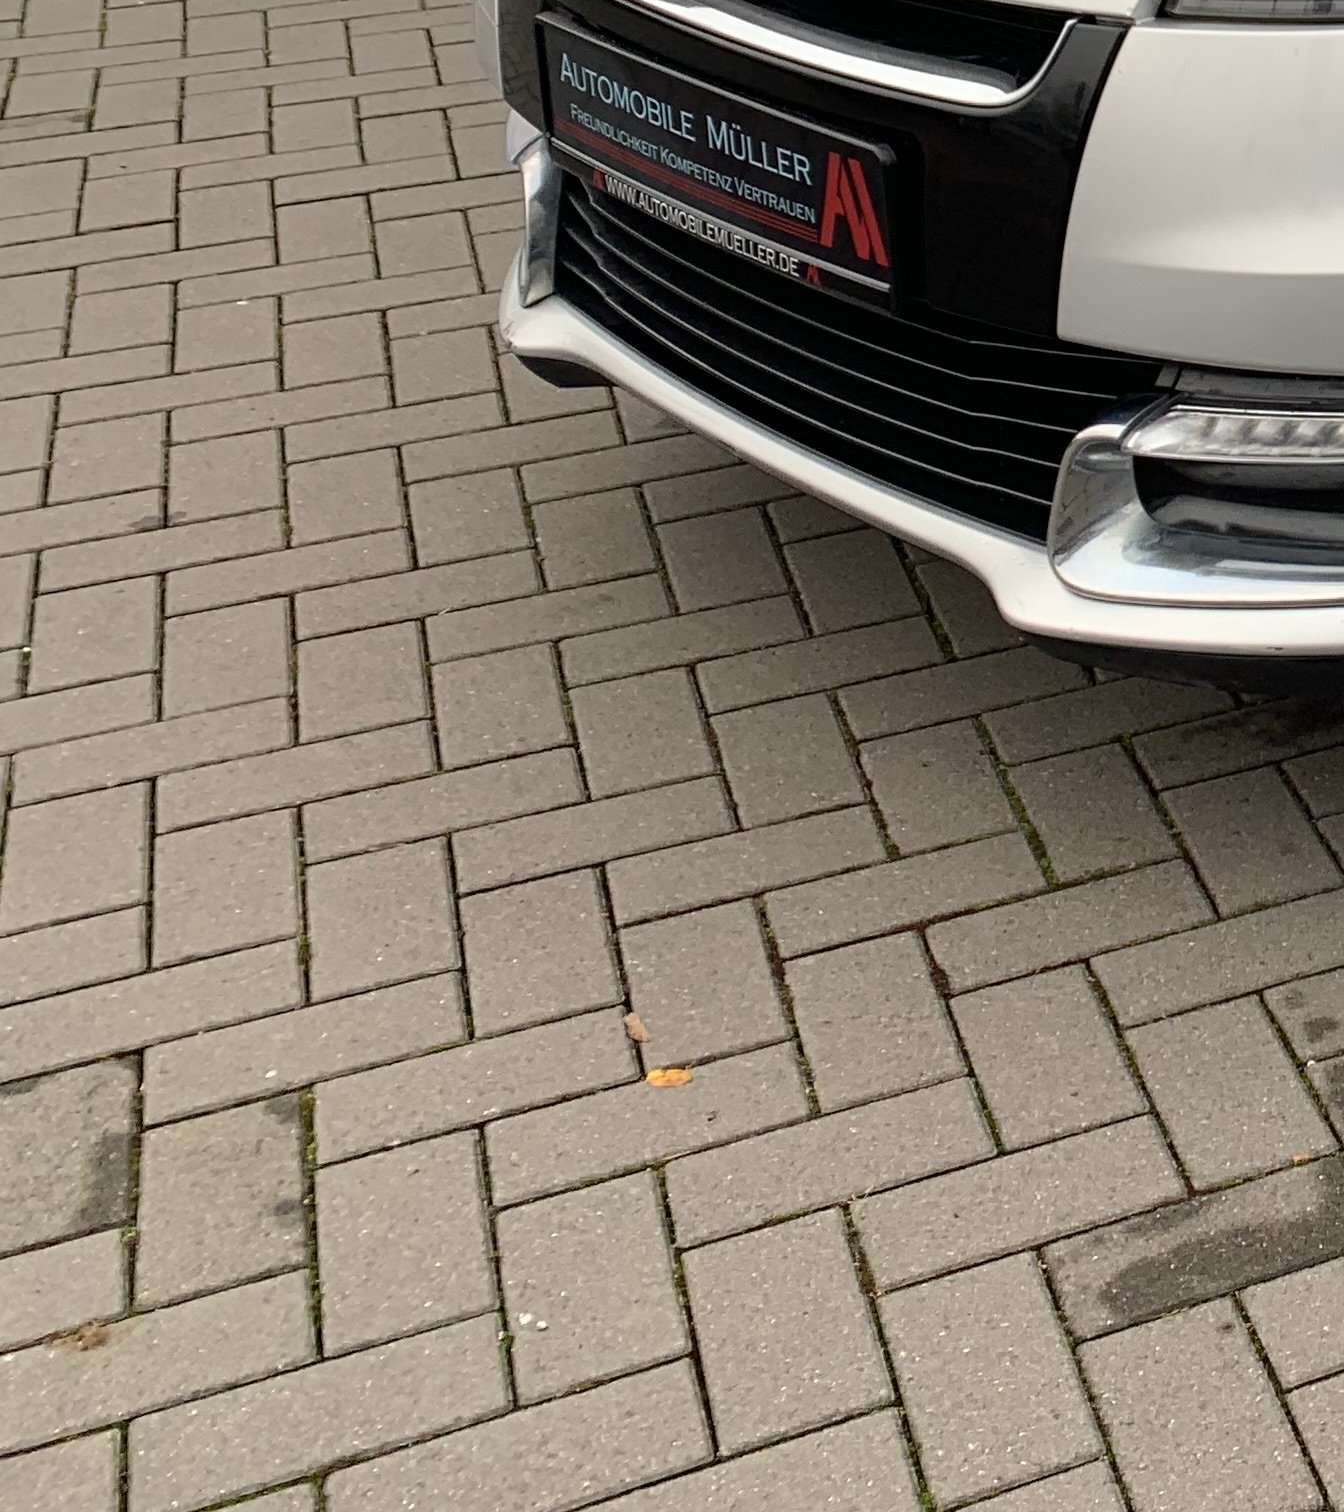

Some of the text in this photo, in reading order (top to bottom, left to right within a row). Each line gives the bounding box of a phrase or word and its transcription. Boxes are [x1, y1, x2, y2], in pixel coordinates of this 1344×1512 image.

[560, 52, 813, 186] AUTOMOBILE MÜLLER
[570, 103, 816, 225] FREUNDLICHKEIT KOMPETENZ VERTRAUEN
[604, 174, 800, 278] WWW.AUTOMOBILEMUELLER.DE
